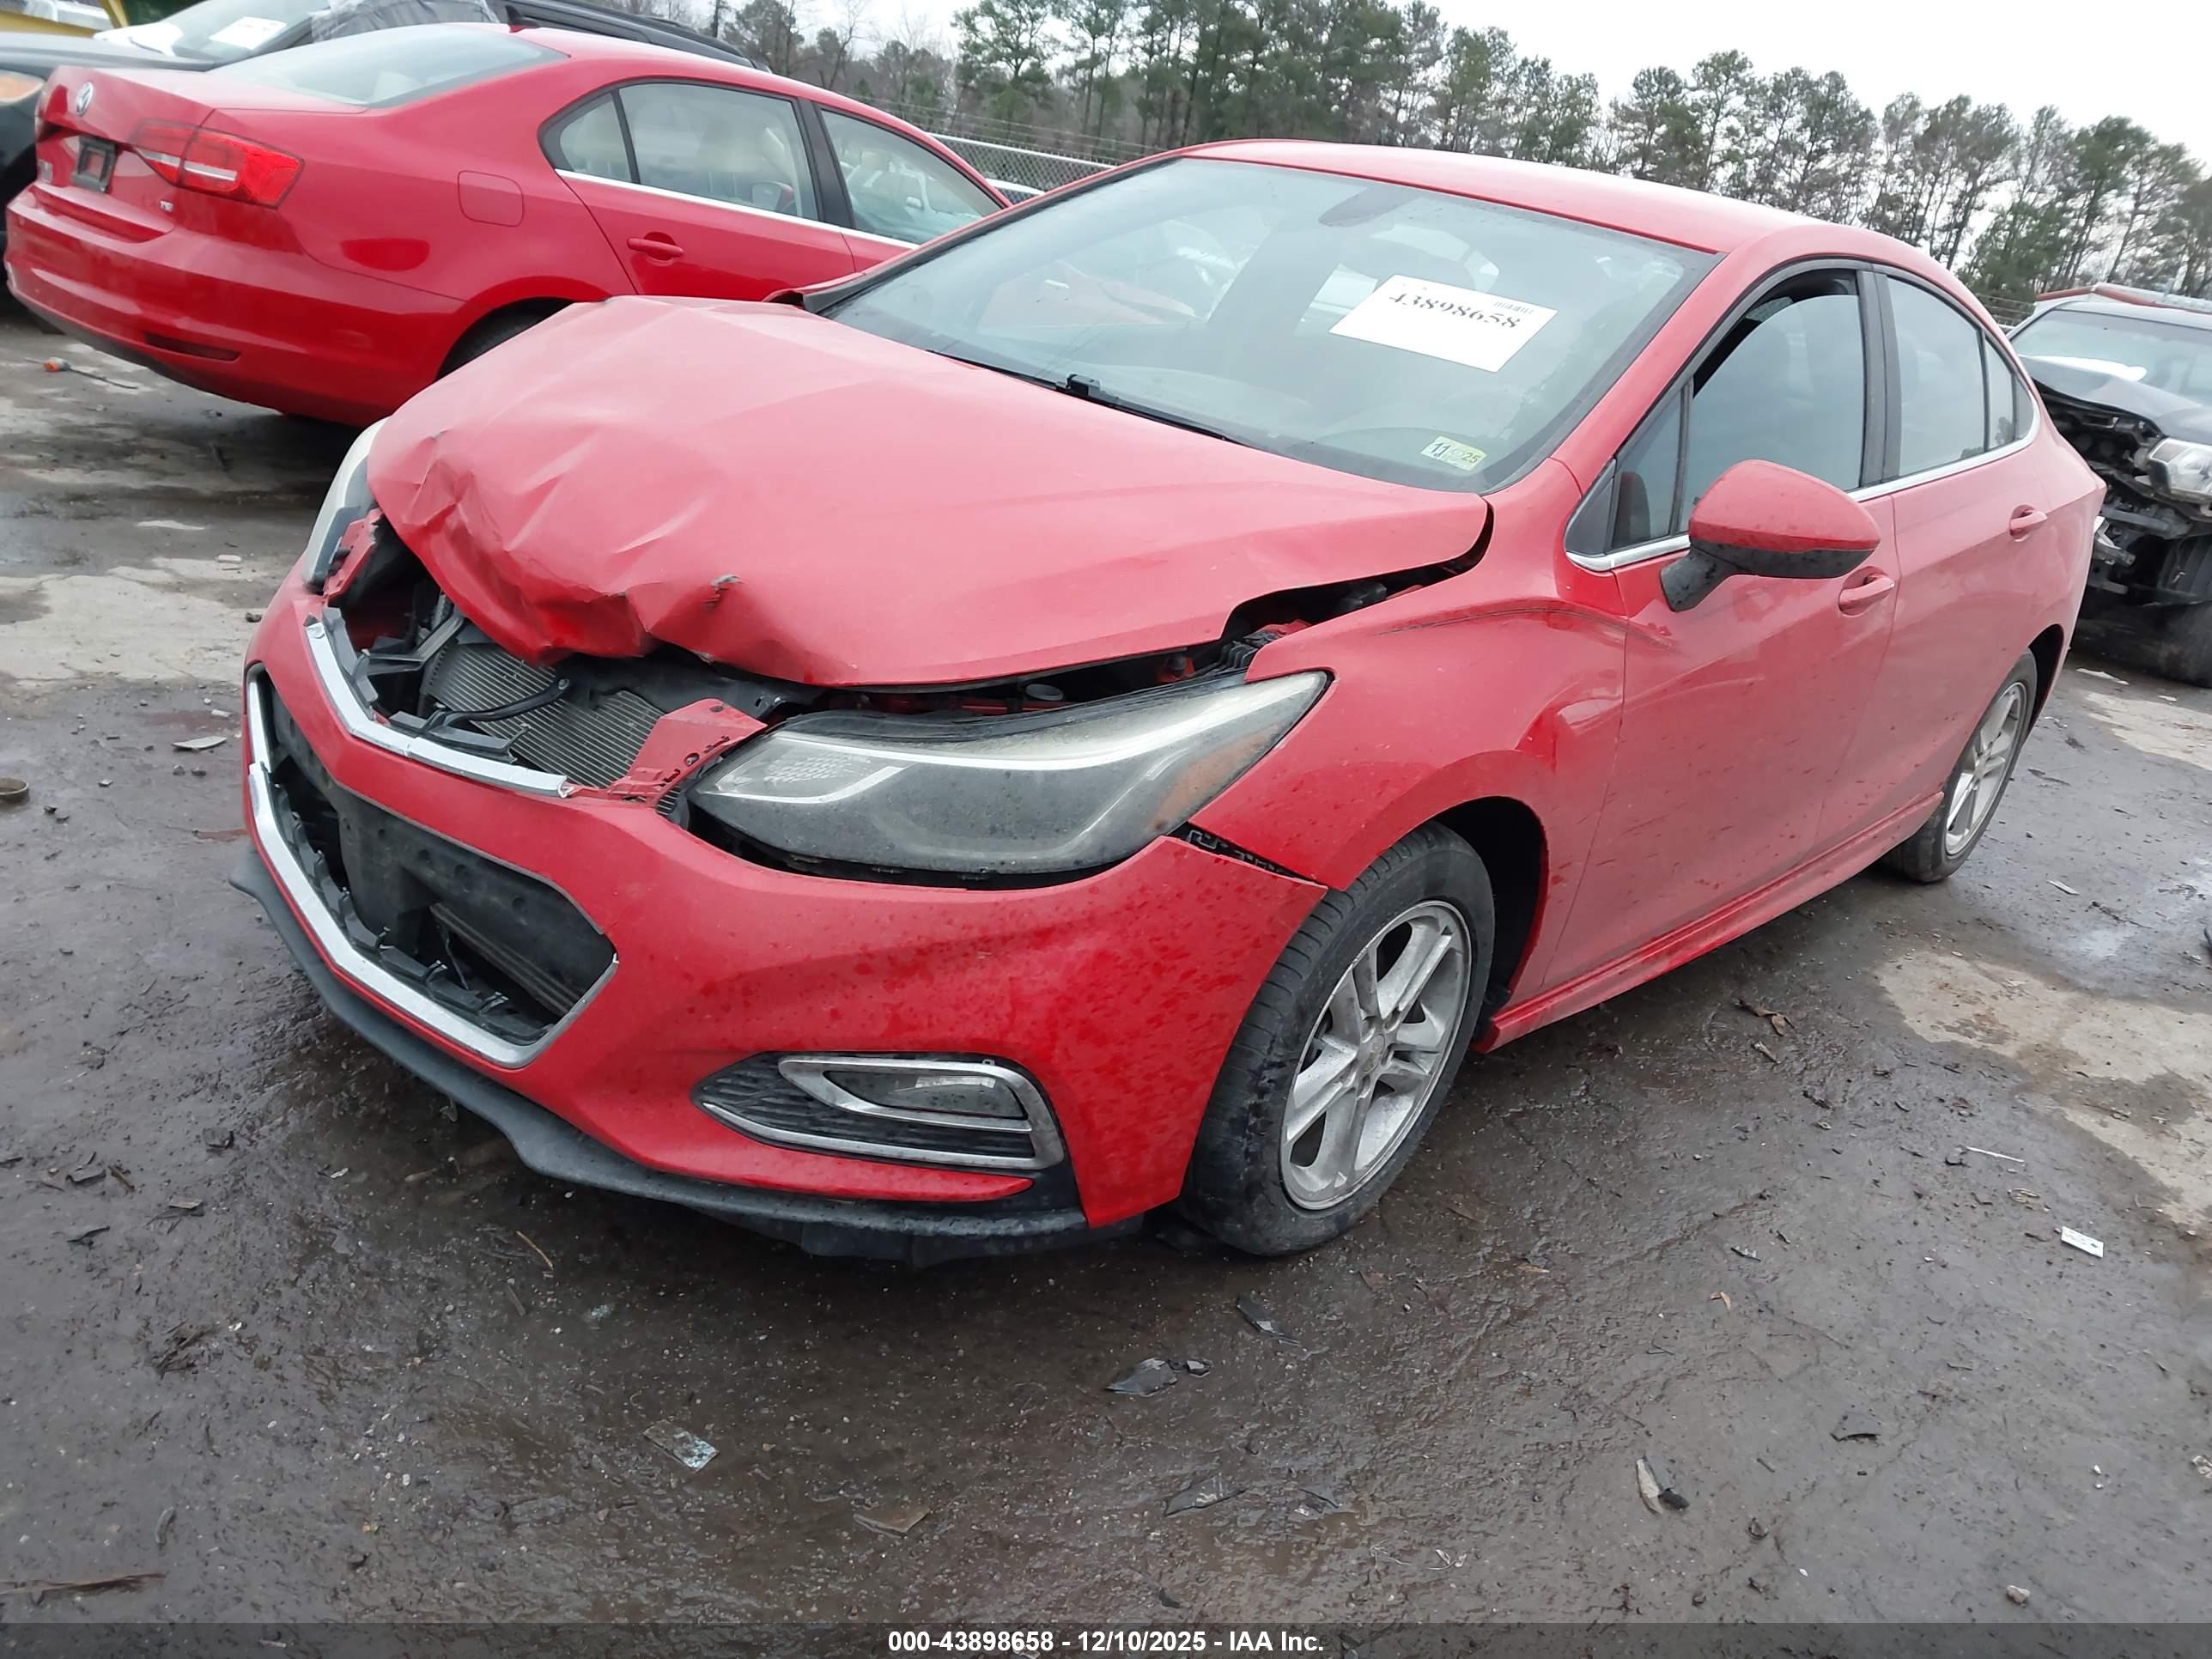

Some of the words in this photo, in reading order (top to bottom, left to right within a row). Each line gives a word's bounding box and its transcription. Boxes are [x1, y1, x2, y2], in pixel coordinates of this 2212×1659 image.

[1389, 293, 1521, 328] 43898658
[1431, 442, 1451, 457] 11
[1462, 453, 1481, 464] 25
